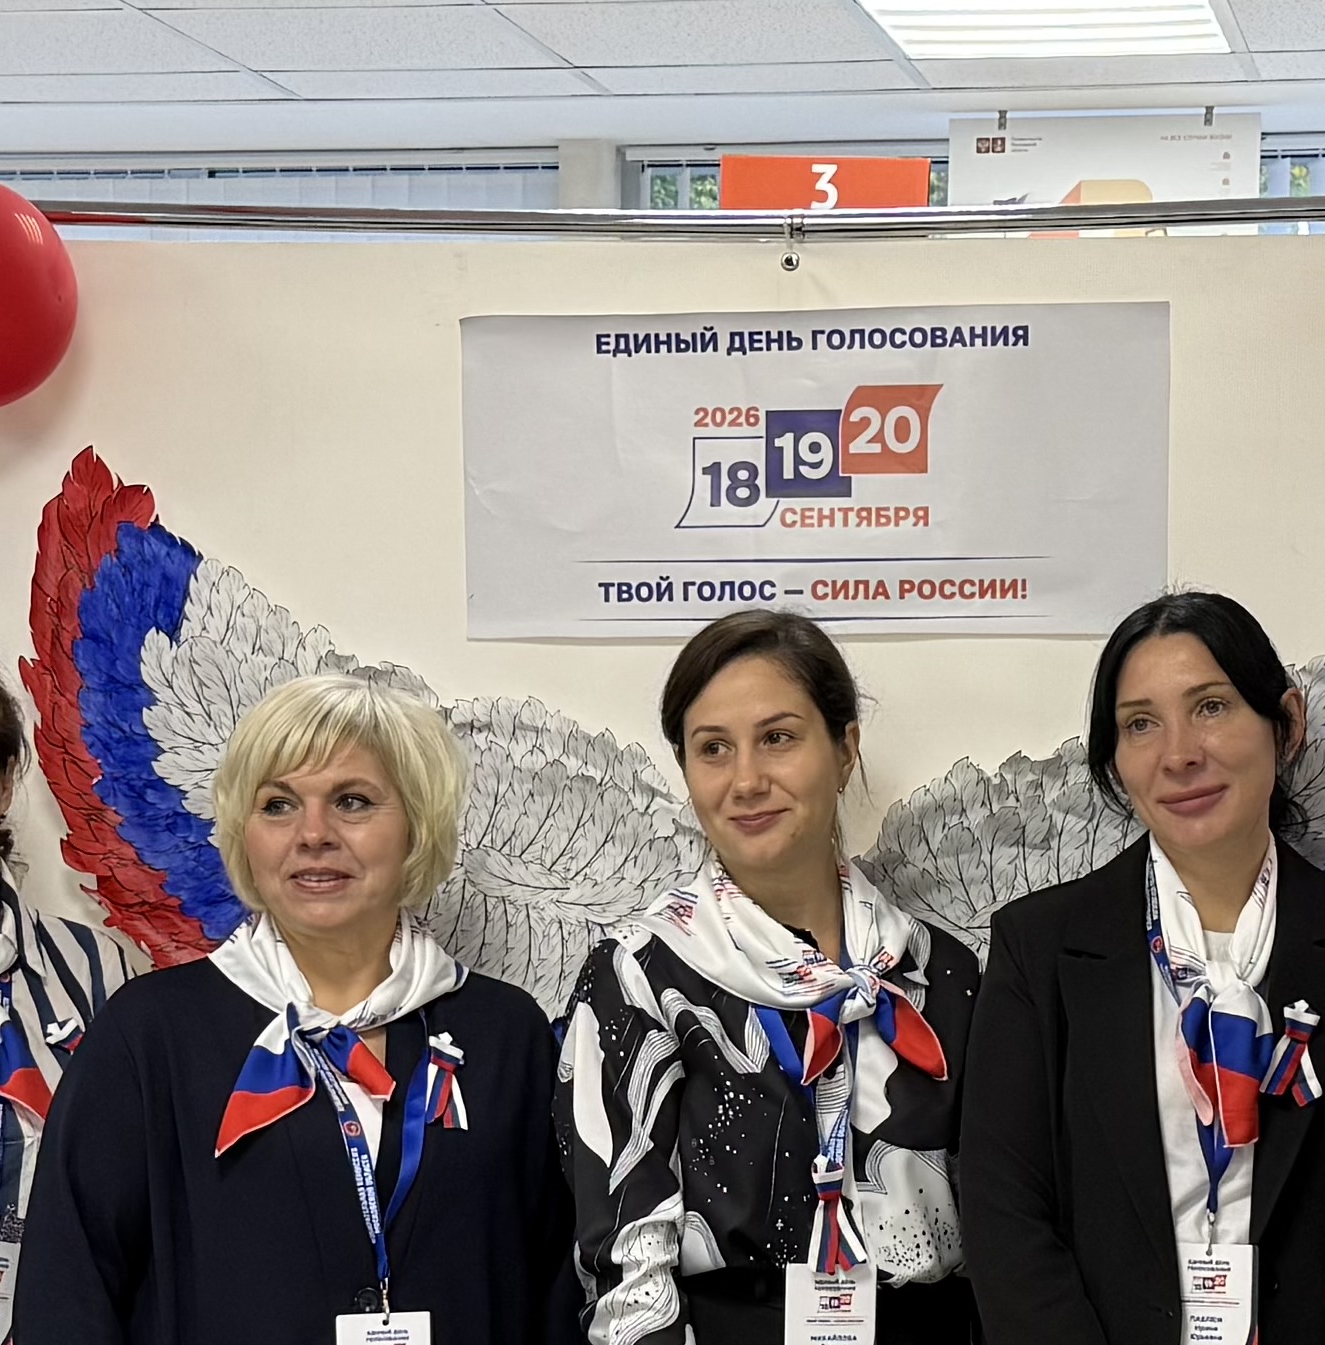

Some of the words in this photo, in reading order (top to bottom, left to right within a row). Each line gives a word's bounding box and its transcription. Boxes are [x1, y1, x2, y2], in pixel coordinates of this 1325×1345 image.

[809, 163, 839, 209] 3
[595, 325, 719, 358] ЕДИНЫЙ
[726, 329, 804, 357] ДЕНЬ
[811, 324, 1030, 351] ГОЛОСОВАНИЯ
[693, 406, 761, 429] 2026
[700, 460, 762, 508] 18
[774, 430, 835, 480] 19
[848, 406, 922, 454] 20
[779, 506, 931, 529] СЕНТЯБРЯ
[597, 576, 674, 603] ТВОЙ
[682, 579, 777, 602] ГОЛОС
[810, 579, 891, 601] СИЛА
[898, 578, 1028, 601] РОССИИ!
